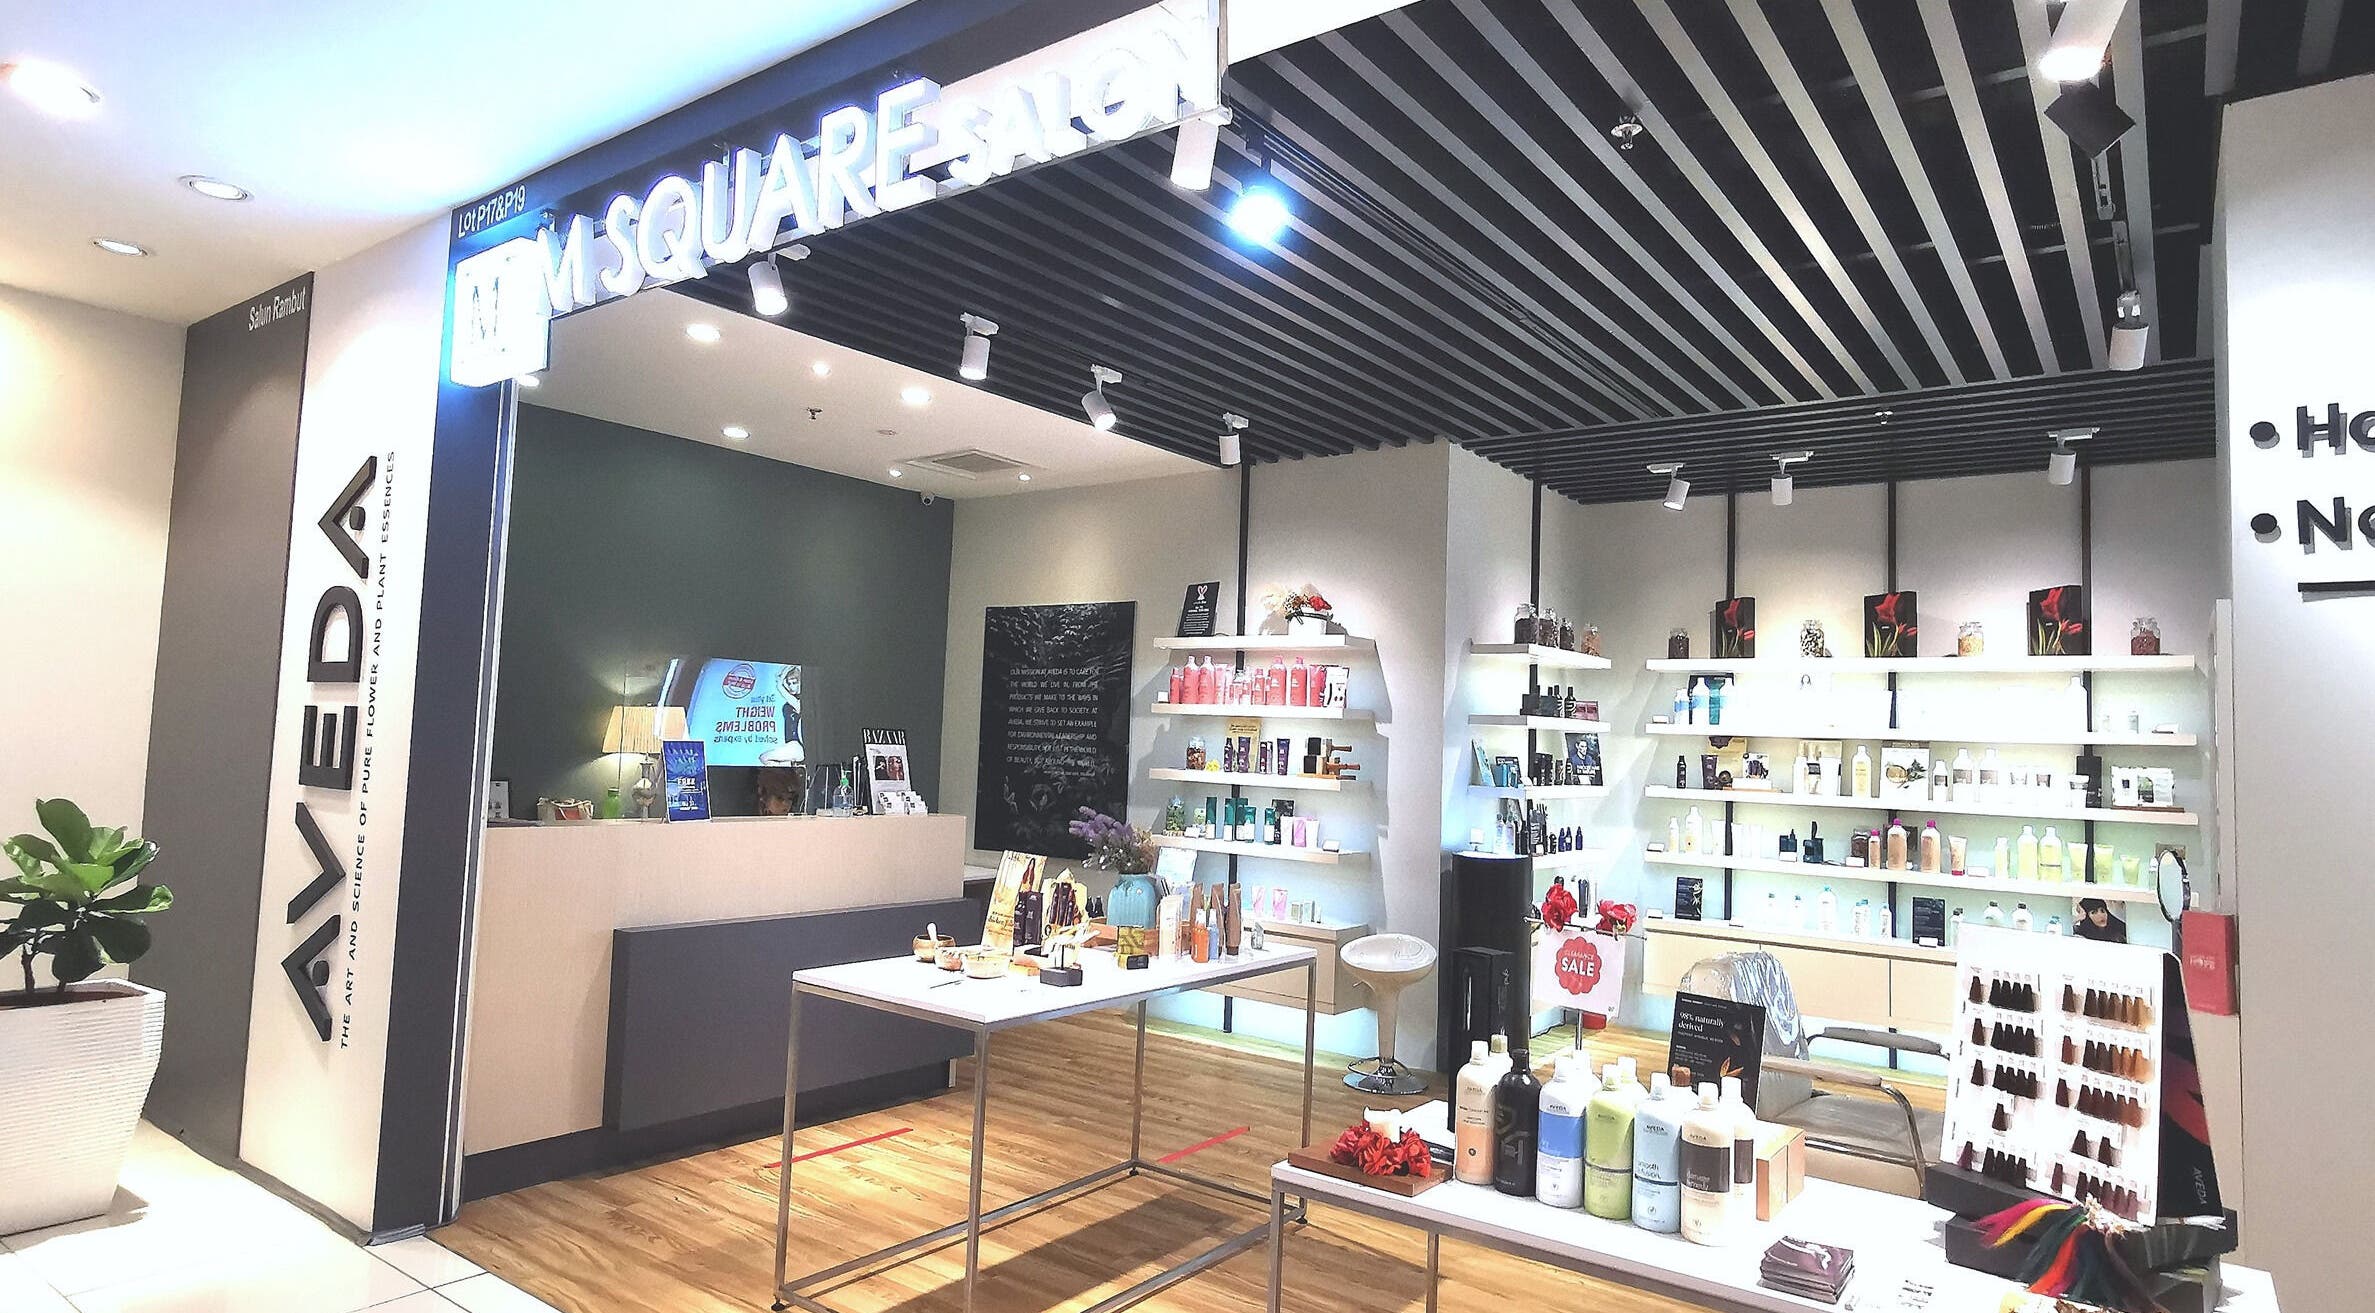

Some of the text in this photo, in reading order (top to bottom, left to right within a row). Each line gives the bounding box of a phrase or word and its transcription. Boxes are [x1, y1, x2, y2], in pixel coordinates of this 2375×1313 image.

[272, 286, 306, 321] Rambut
[532, 0, 1218, 316] M SQUARE SALON
[281, 455, 378, 1042] AVEDA
[339, 450, 395, 1050] THE ART AND SCIENCE OF PURE FLOWER AND PLANT ESSENCES
[1561, 956, 1595, 977] SALE
